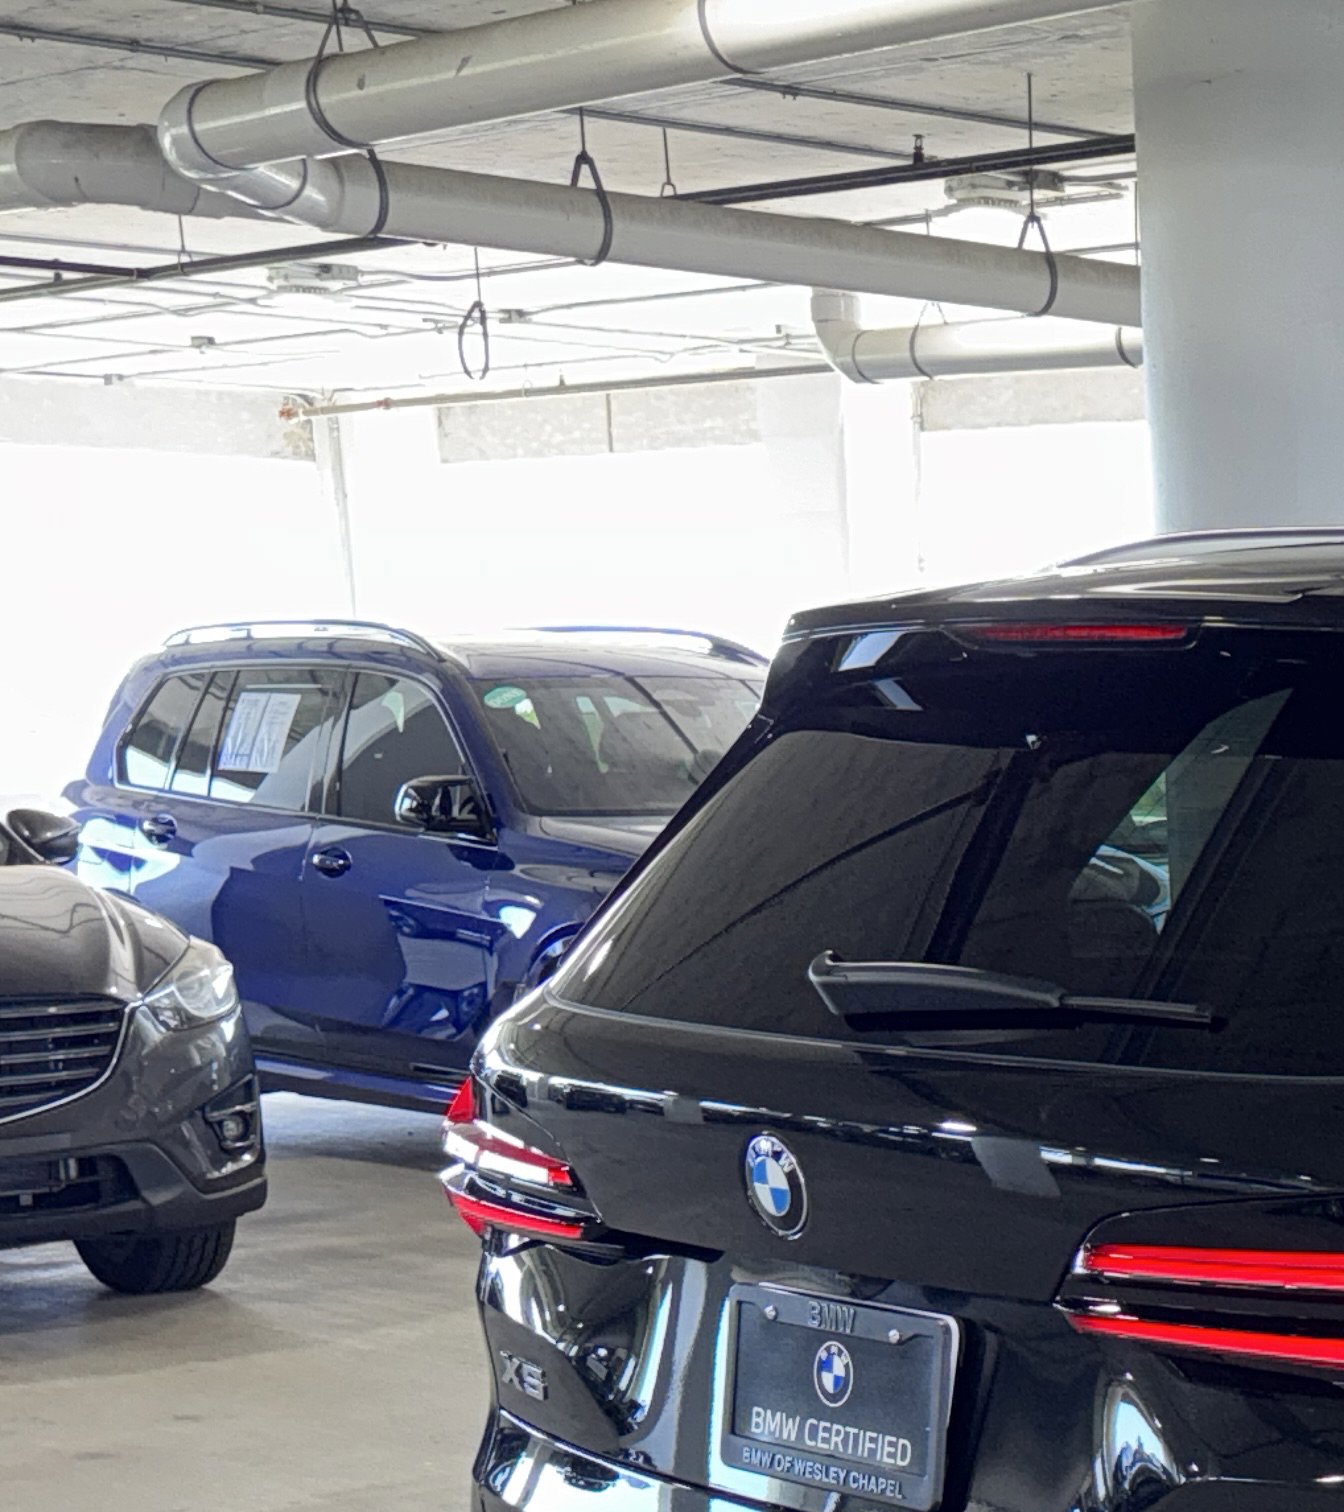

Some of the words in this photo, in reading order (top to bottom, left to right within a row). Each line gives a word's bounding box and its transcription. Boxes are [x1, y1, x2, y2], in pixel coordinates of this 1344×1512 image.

[808, 1300, 855, 1334] BMW
[500, 1350, 545, 1401] X5
[751, 1406, 801, 1442] BMW
[804, 1418, 912, 1467] CERTIFIED
[742, 1446, 774, 1469] BMW
[774, 1454, 794, 1473] OF
[793, 1459, 847, 1486] WESLEY
[849, 1471, 904, 1499] CHAPEL
